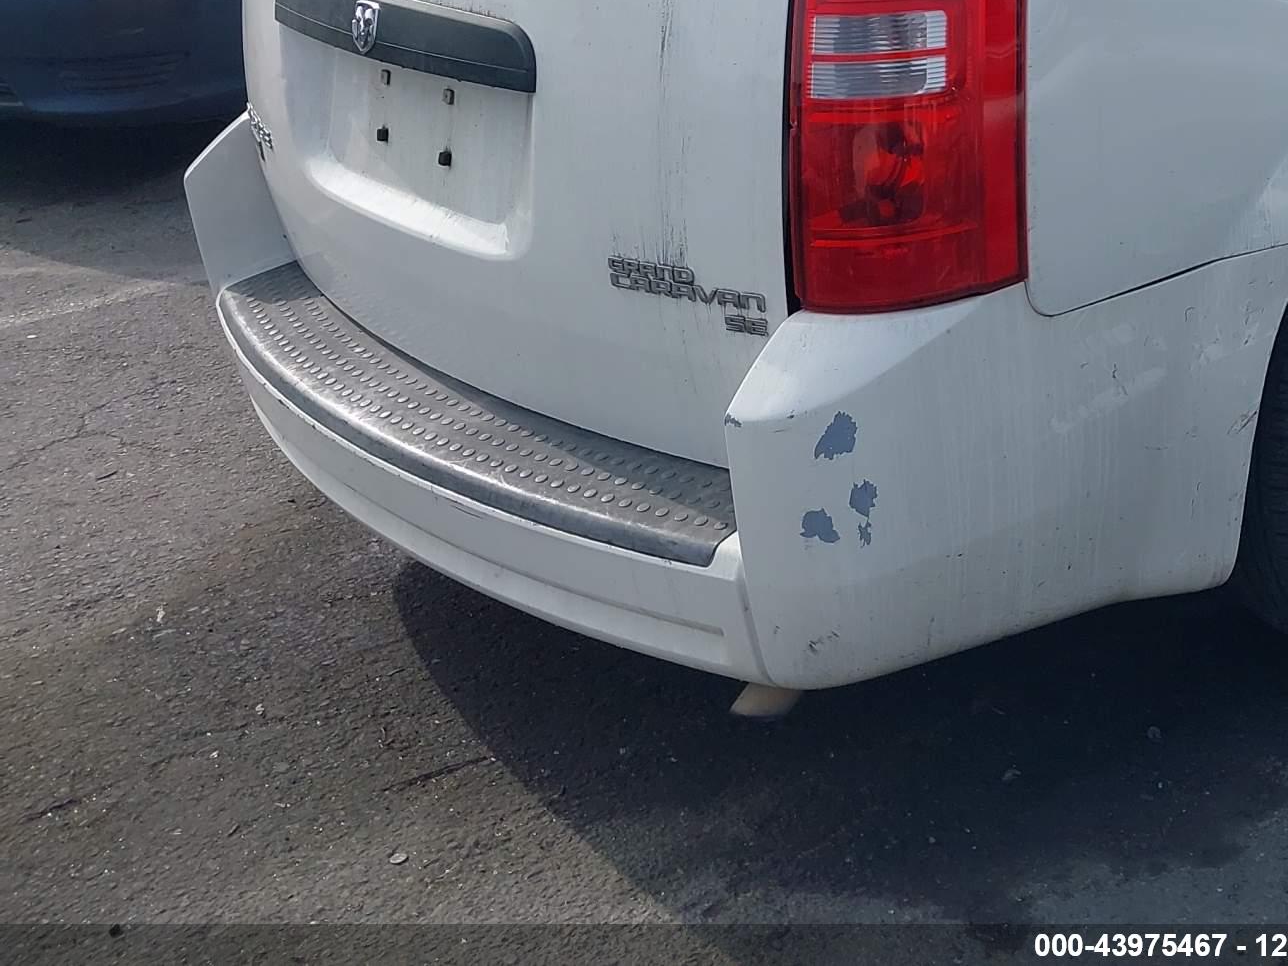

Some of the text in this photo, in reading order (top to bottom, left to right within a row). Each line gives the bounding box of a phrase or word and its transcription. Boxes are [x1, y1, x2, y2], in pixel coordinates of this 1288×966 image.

[608, 256, 694, 285] GRAND
[610, 273, 767, 313] CARAVAN
[724, 314, 768, 336] SE
